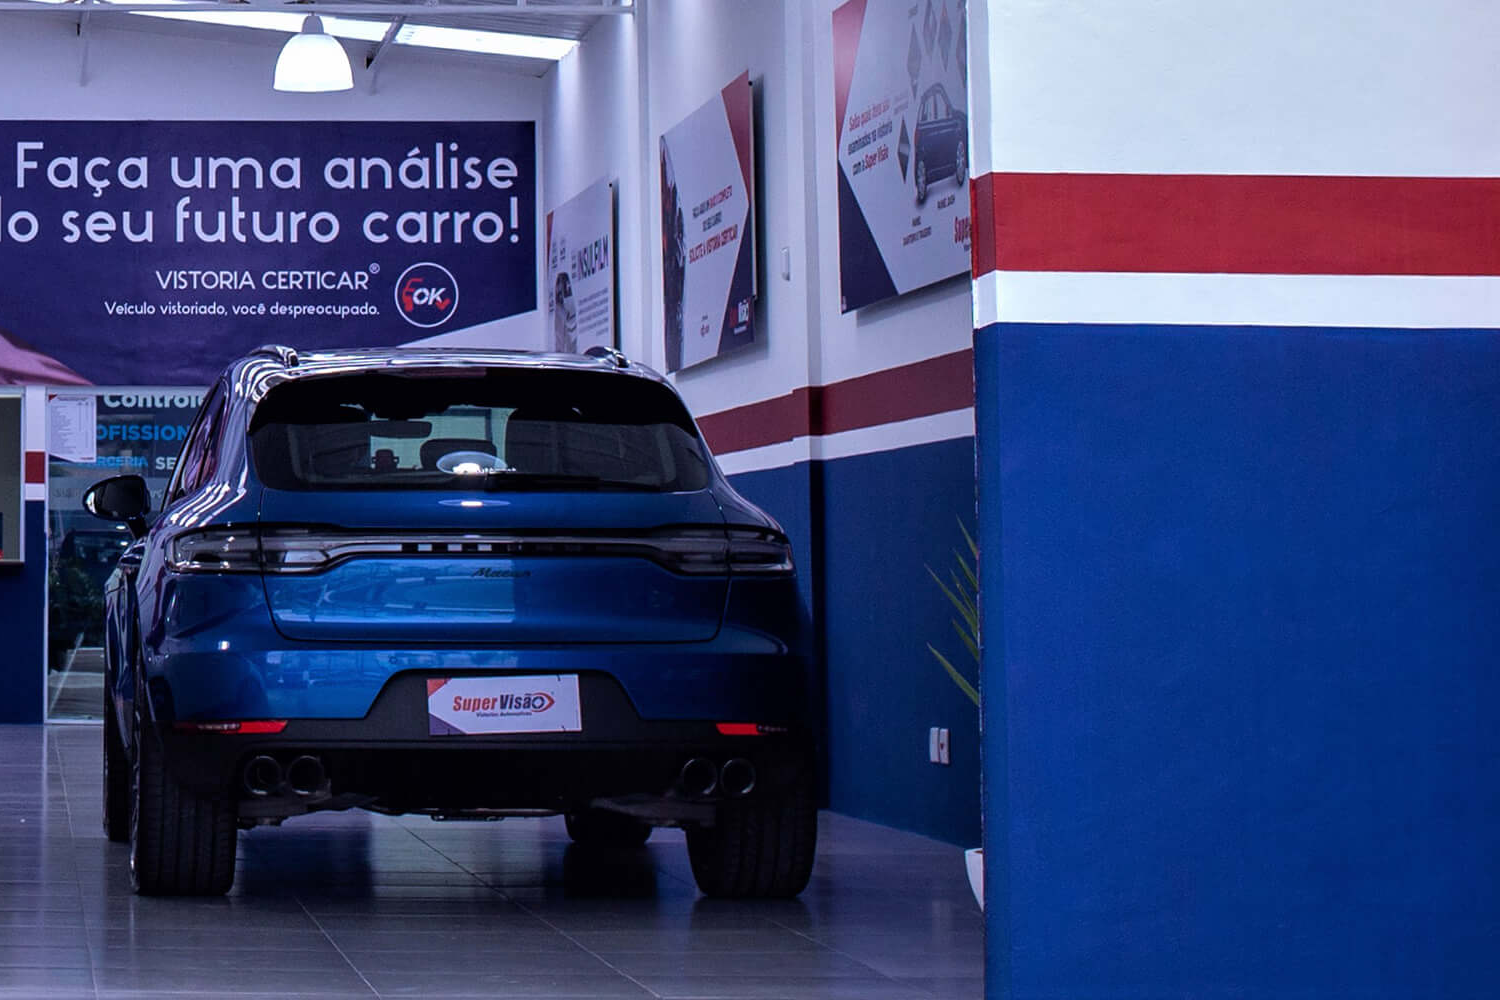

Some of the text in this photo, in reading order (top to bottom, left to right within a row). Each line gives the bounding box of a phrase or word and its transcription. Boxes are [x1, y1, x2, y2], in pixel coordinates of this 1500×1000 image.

[16, 142, 518, 198] Faça uma análise
[62, 208, 154, 244] seu
[176, 195, 340, 244] futuro
[362, 196, 520, 244] carro!
[155, 270, 256, 290] VISTORIA
[104, 301, 381, 320] Veículo vistoriado, você despreocupado.
[97, 424, 190, 441] OFISSION
[155, 456, 177, 470] SE
[452, 693, 545, 712] Super Visão
